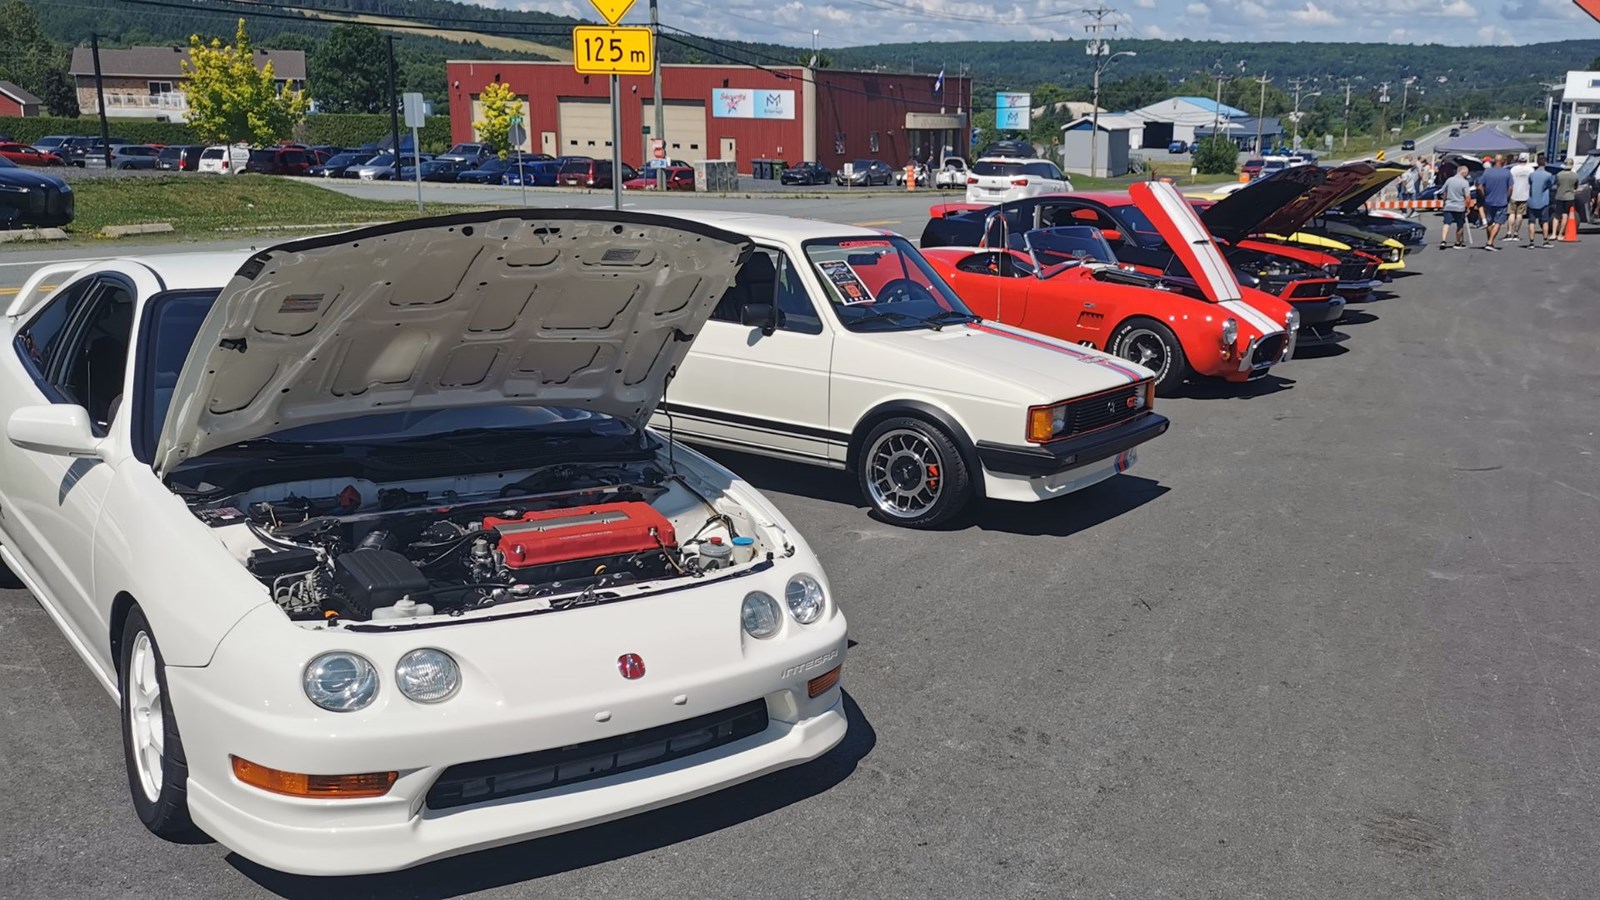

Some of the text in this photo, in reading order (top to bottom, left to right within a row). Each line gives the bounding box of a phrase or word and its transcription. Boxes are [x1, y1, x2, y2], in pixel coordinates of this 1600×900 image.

[585, 37, 646, 62] 125 m
[781, 650, 839, 679] INTEGRA
